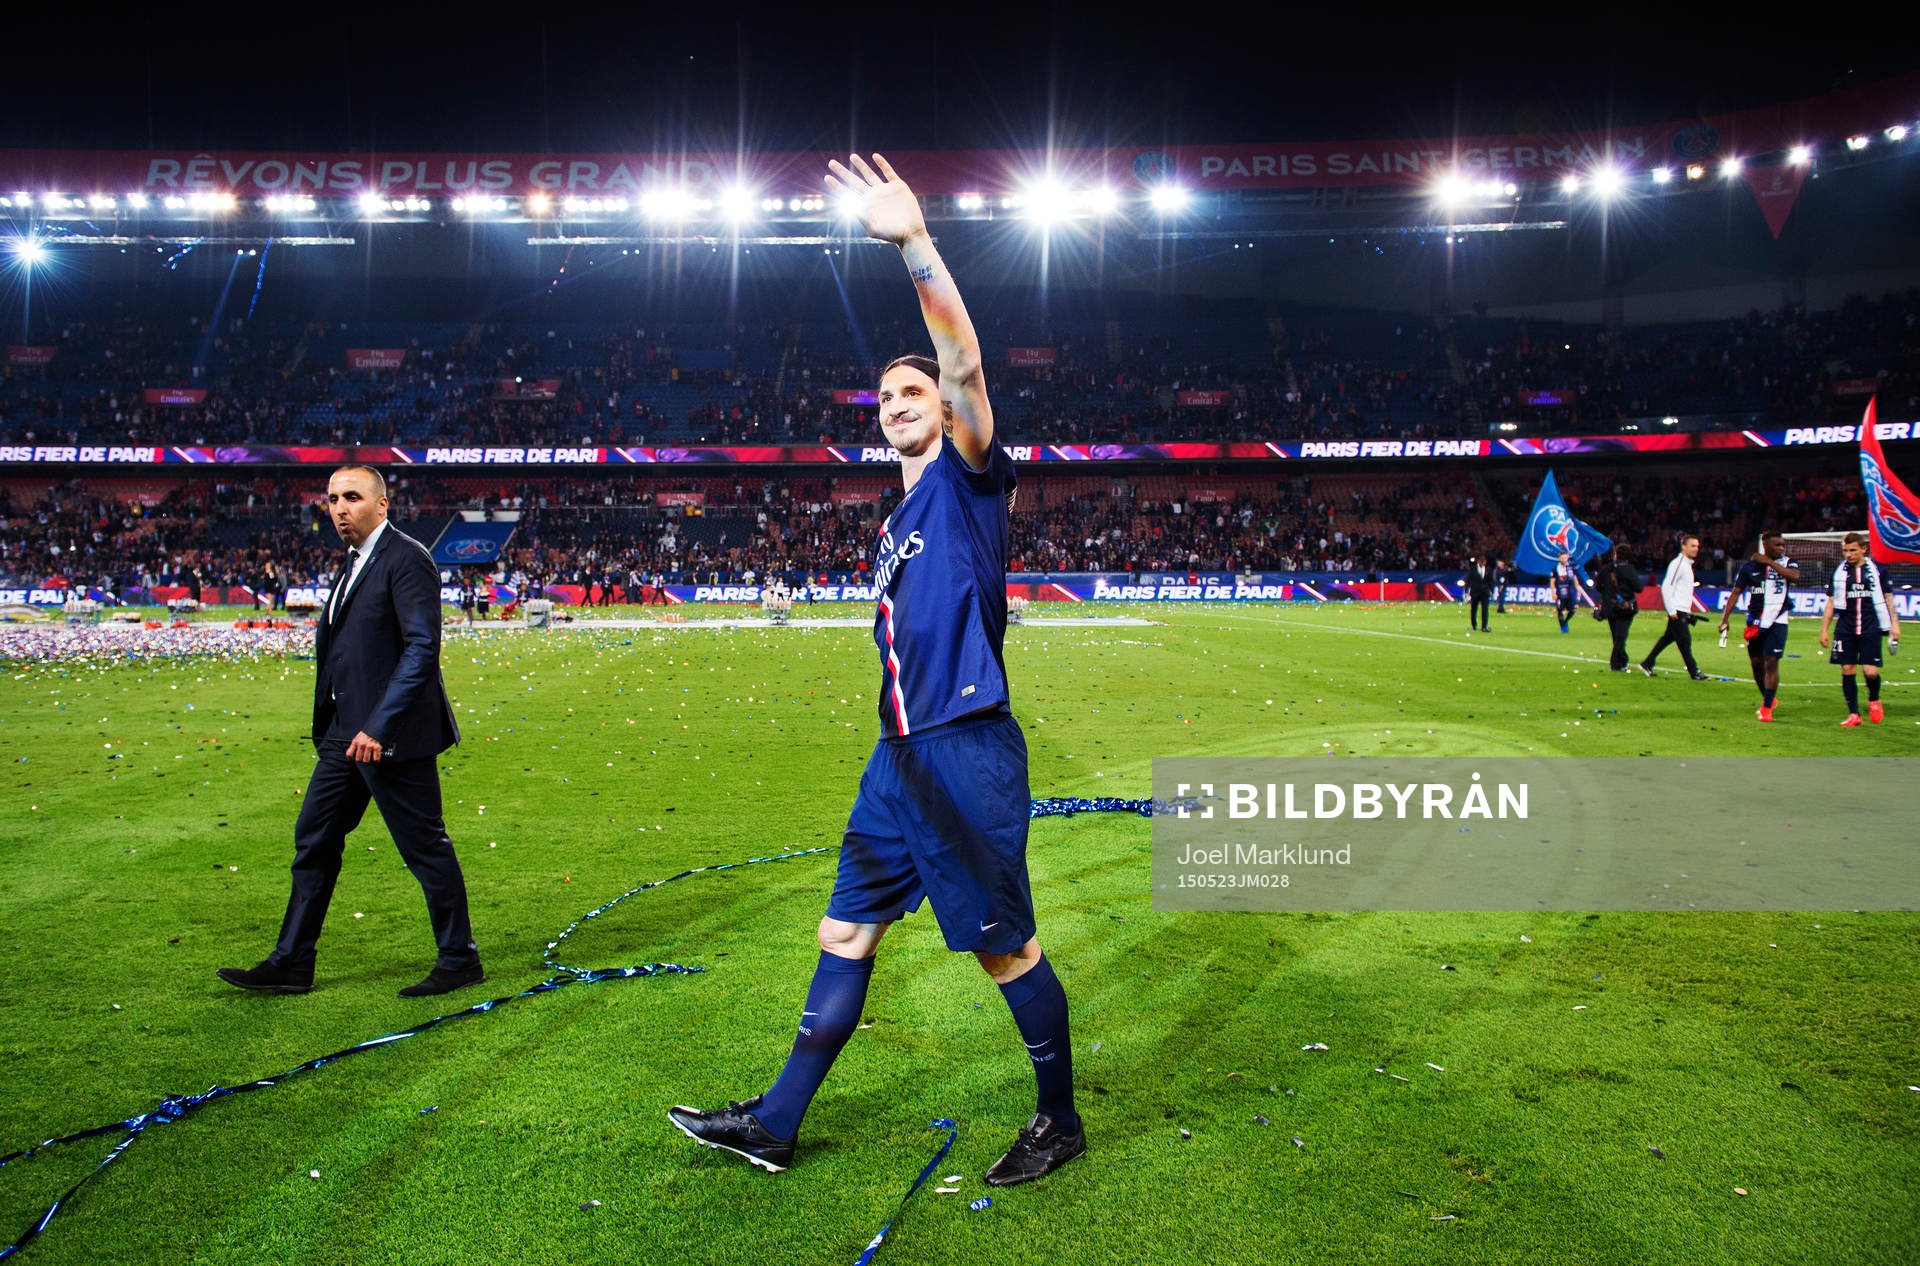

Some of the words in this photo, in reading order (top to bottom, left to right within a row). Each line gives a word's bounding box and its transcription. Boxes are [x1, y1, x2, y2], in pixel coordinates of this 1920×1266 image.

[145, 153, 363, 190] RÊVONS
[379, 161, 513, 191] PLUS
[529, 161, 715, 191] GRAND
[1201, 155, 1317, 178] PARIS
[1784, 425, 1855, 445] PARIS
[34, 447, 77, 462] FIER
[79, 447, 106, 462] DE
[108, 447, 164, 463] PARIS
[426, 448, 484, 463] PARIS
[484, 448, 525, 463] FIER
[526, 448, 553, 463] DE
[554, 448, 607, 464] PARIS
[861, 447, 900, 461] PAR
[1301, 442, 1360, 457] PARIS
[1360, 442, 1403, 456] FIER
[1404, 441, 1432, 456] DE
[1433, 440, 1491, 456] PARIS
[286, 588, 331, 604] PAR
[695, 587, 759, 601] PARIS
[1094, 585, 1155, 600] PARIS
[1158, 585, 1203, 600] FIER
[1204, 585, 1233, 599] DE
[1235, 585, 1293, 600] PARIS
[1519, 587, 1535, 602] DE
